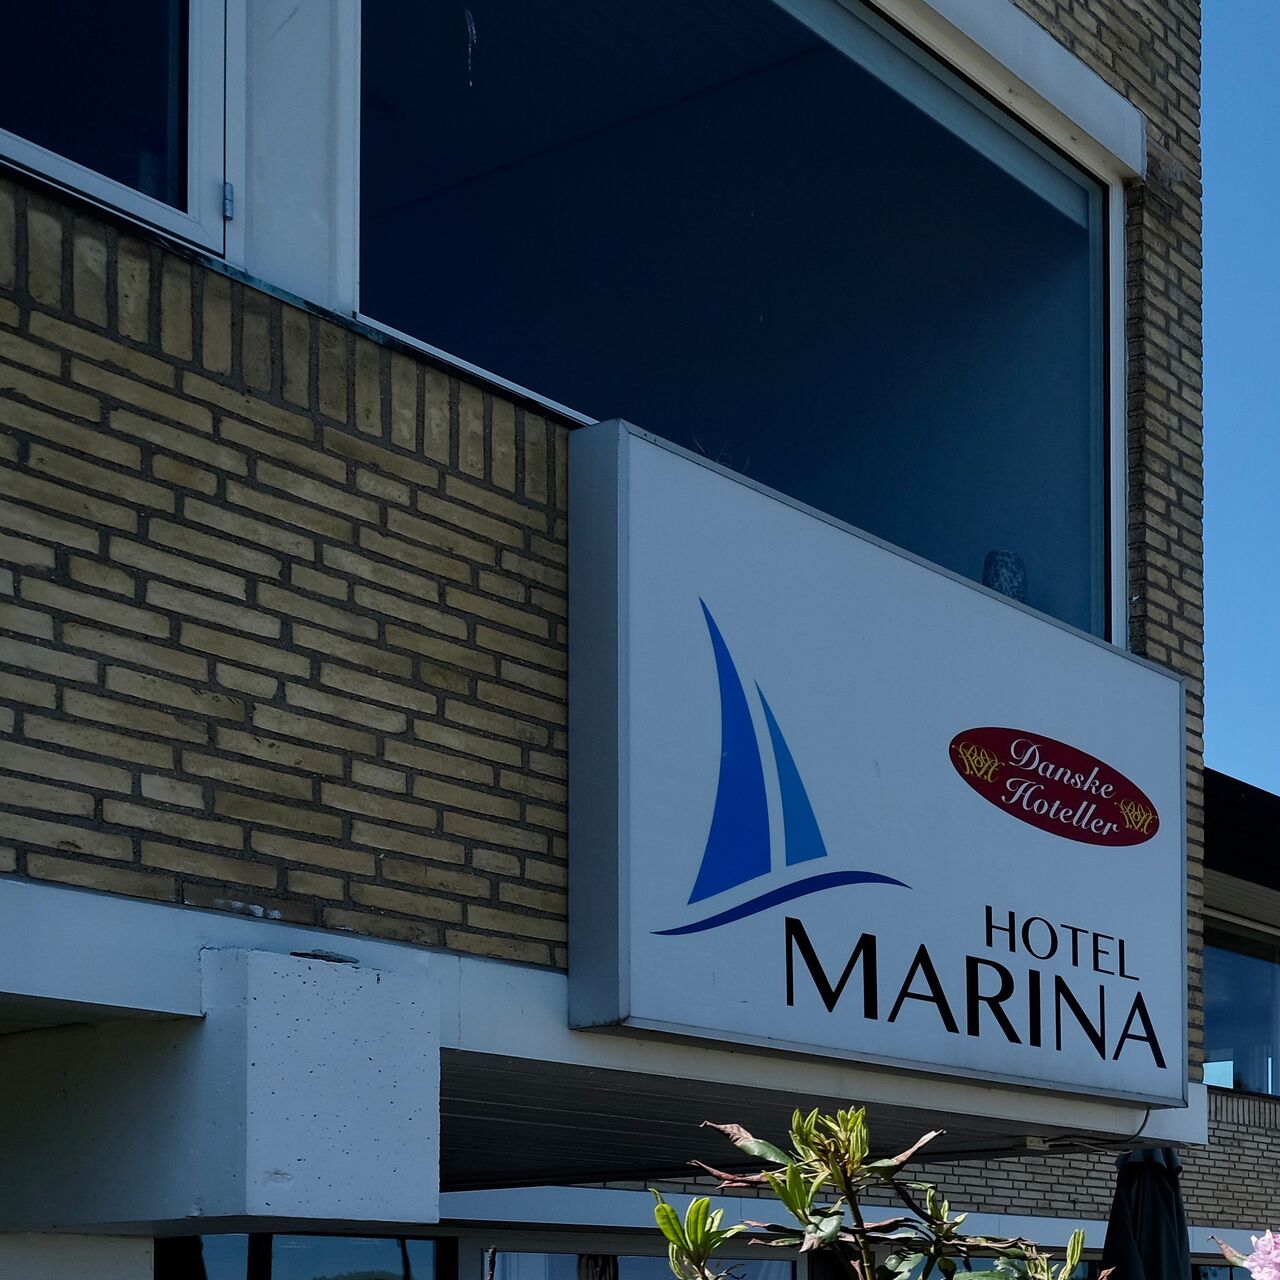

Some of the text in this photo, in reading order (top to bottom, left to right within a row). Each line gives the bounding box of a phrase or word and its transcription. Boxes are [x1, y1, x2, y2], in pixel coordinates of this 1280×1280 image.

[1009, 738, 1117, 799] Danske
[1001, 778, 1121, 836] Hoteller
[984, 904, 1140, 982] HOTEL
[784, 916, 1168, 1070] MARINA
